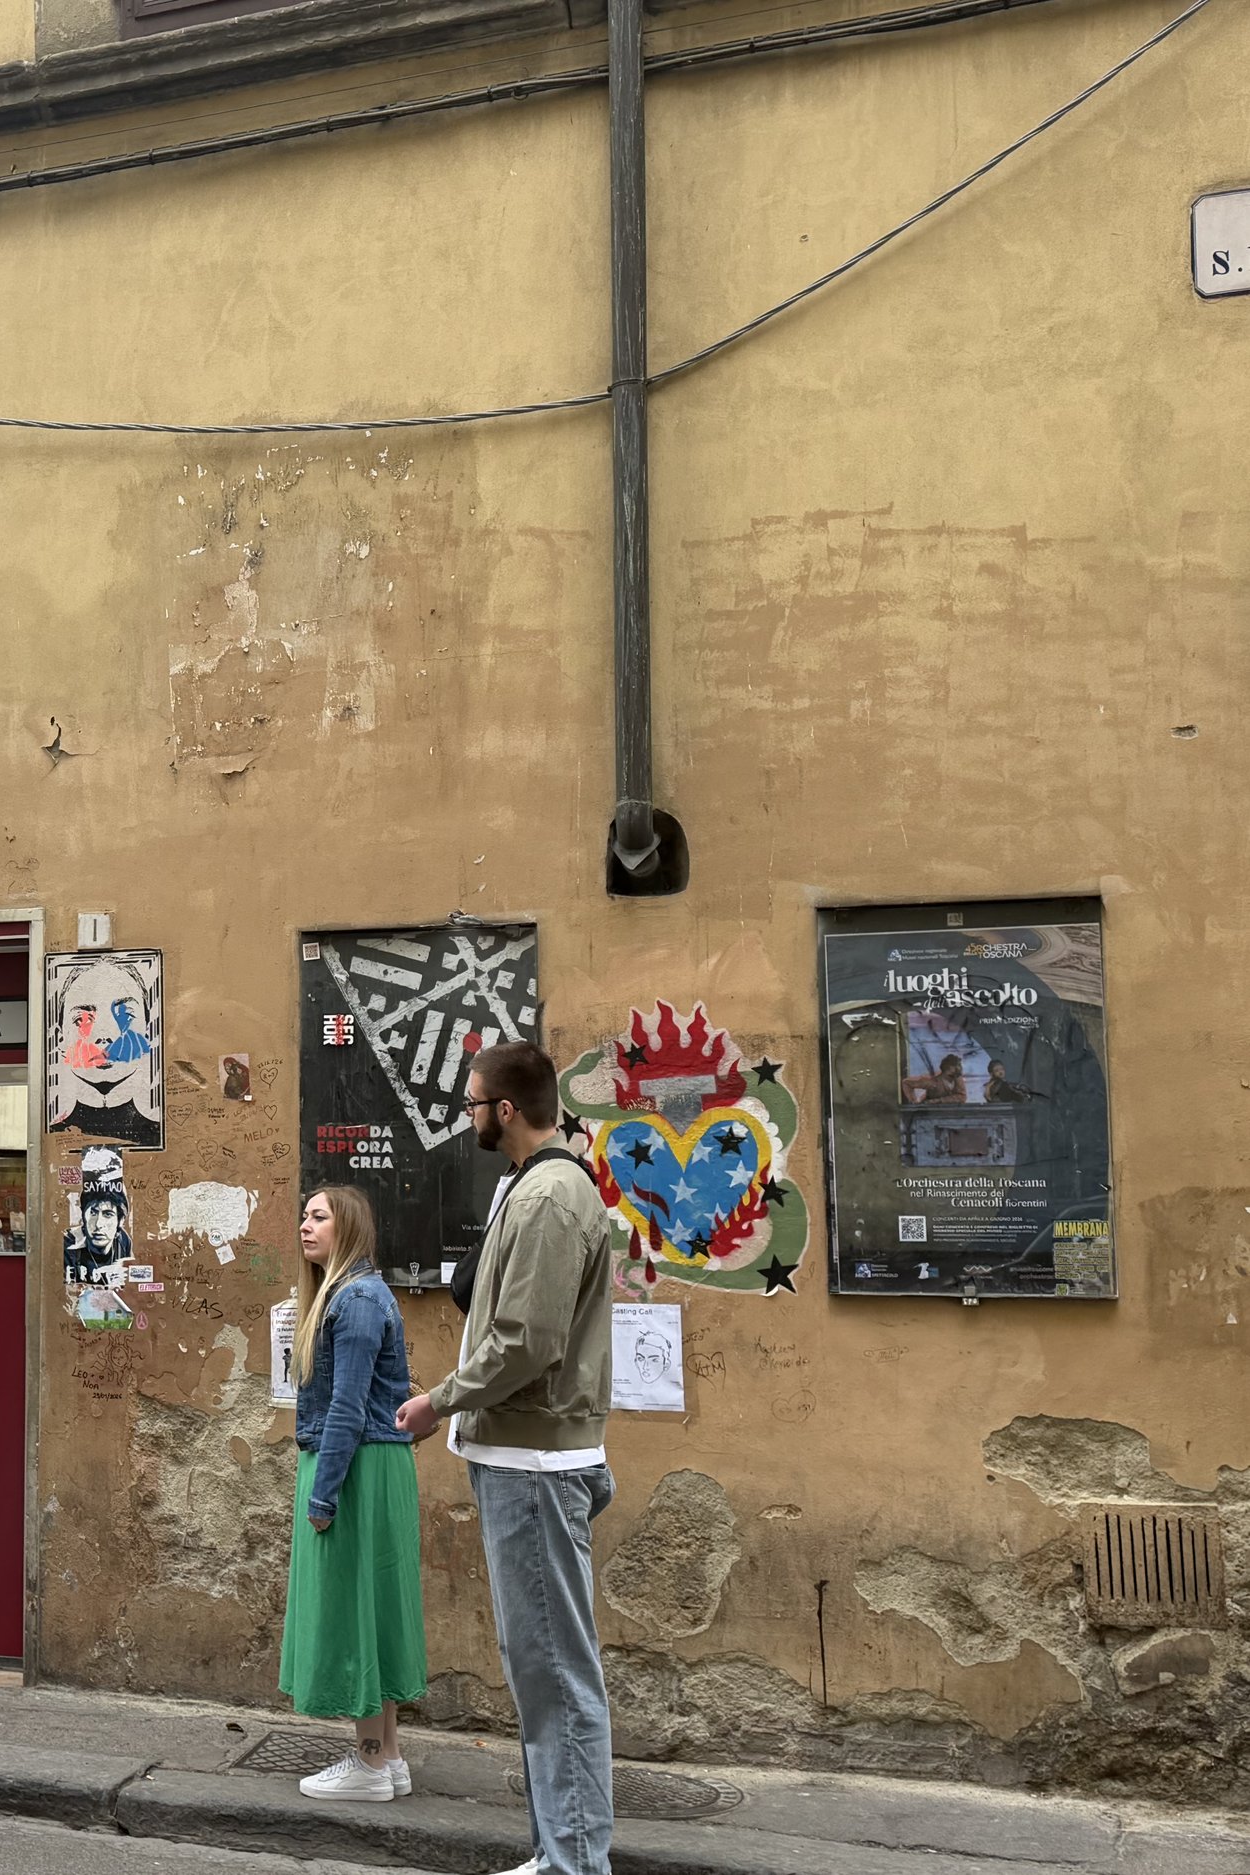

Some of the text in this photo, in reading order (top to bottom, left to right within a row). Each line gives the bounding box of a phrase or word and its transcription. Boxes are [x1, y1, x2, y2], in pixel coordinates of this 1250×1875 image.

[1212, 250, 1243, 276] S.
[888, 966, 969, 998] luoghi
[945, 983, 1038, 1008] ascolto
[317, 1125, 394, 1138] RICORDA
[317, 1141, 394, 1154] ESPLORA
[349, 1156, 394, 1169] CREA
[964, 1178, 994, 1188] della
[999, 1178, 1047, 1188] Toscana
[910, 1189, 924, 1198] nel
[926, 1189, 988, 1198] Rinascimento
[951, 1197, 1048, 1208] Cenacoli fiorentini
[1054, 1221, 1110, 1237] MEMBRANA
